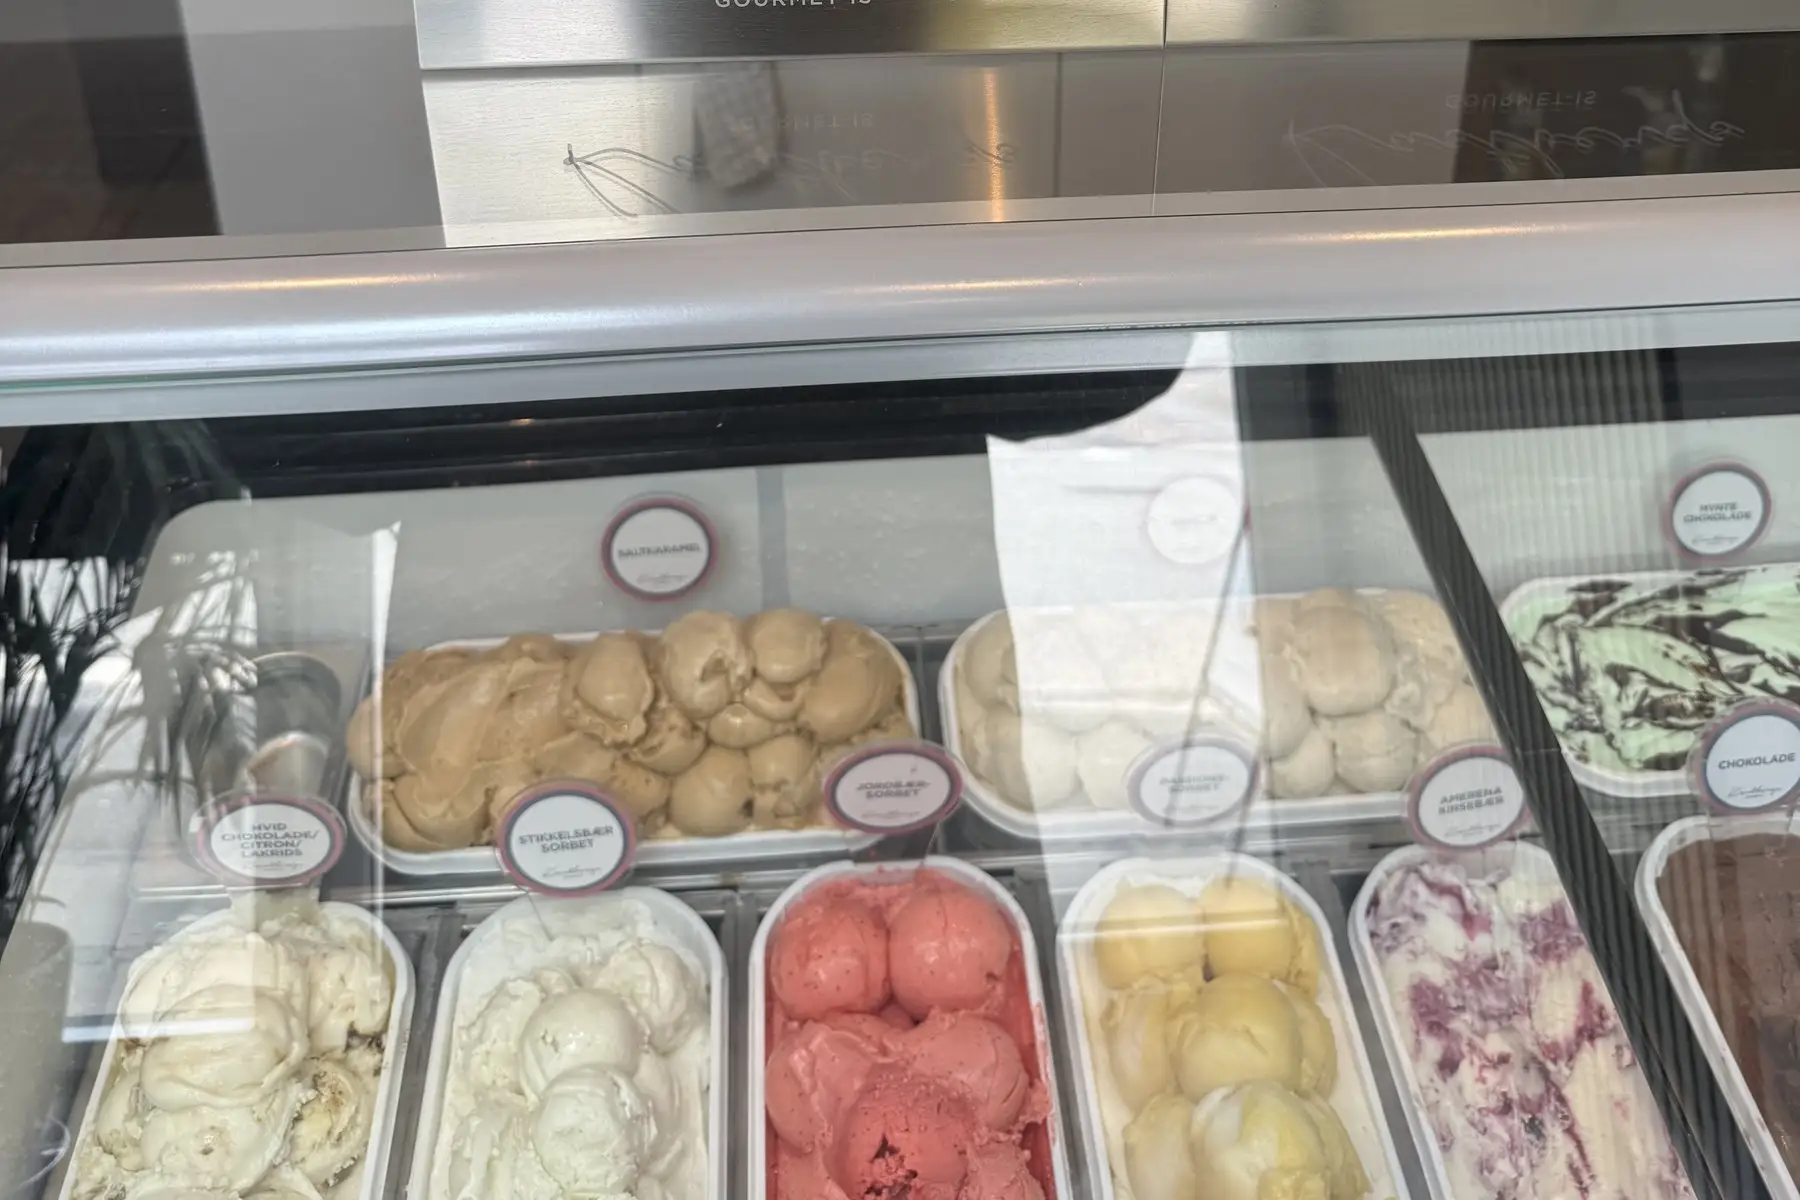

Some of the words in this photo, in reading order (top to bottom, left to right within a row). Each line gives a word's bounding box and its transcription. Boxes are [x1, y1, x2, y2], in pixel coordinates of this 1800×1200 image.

[1718, 753, 1797, 770] CHOKOLADE
[252, 822, 287, 831] HVID
[541, 838, 595, 854] SORBET
[241, 849, 303, 858] LAKRIDS
